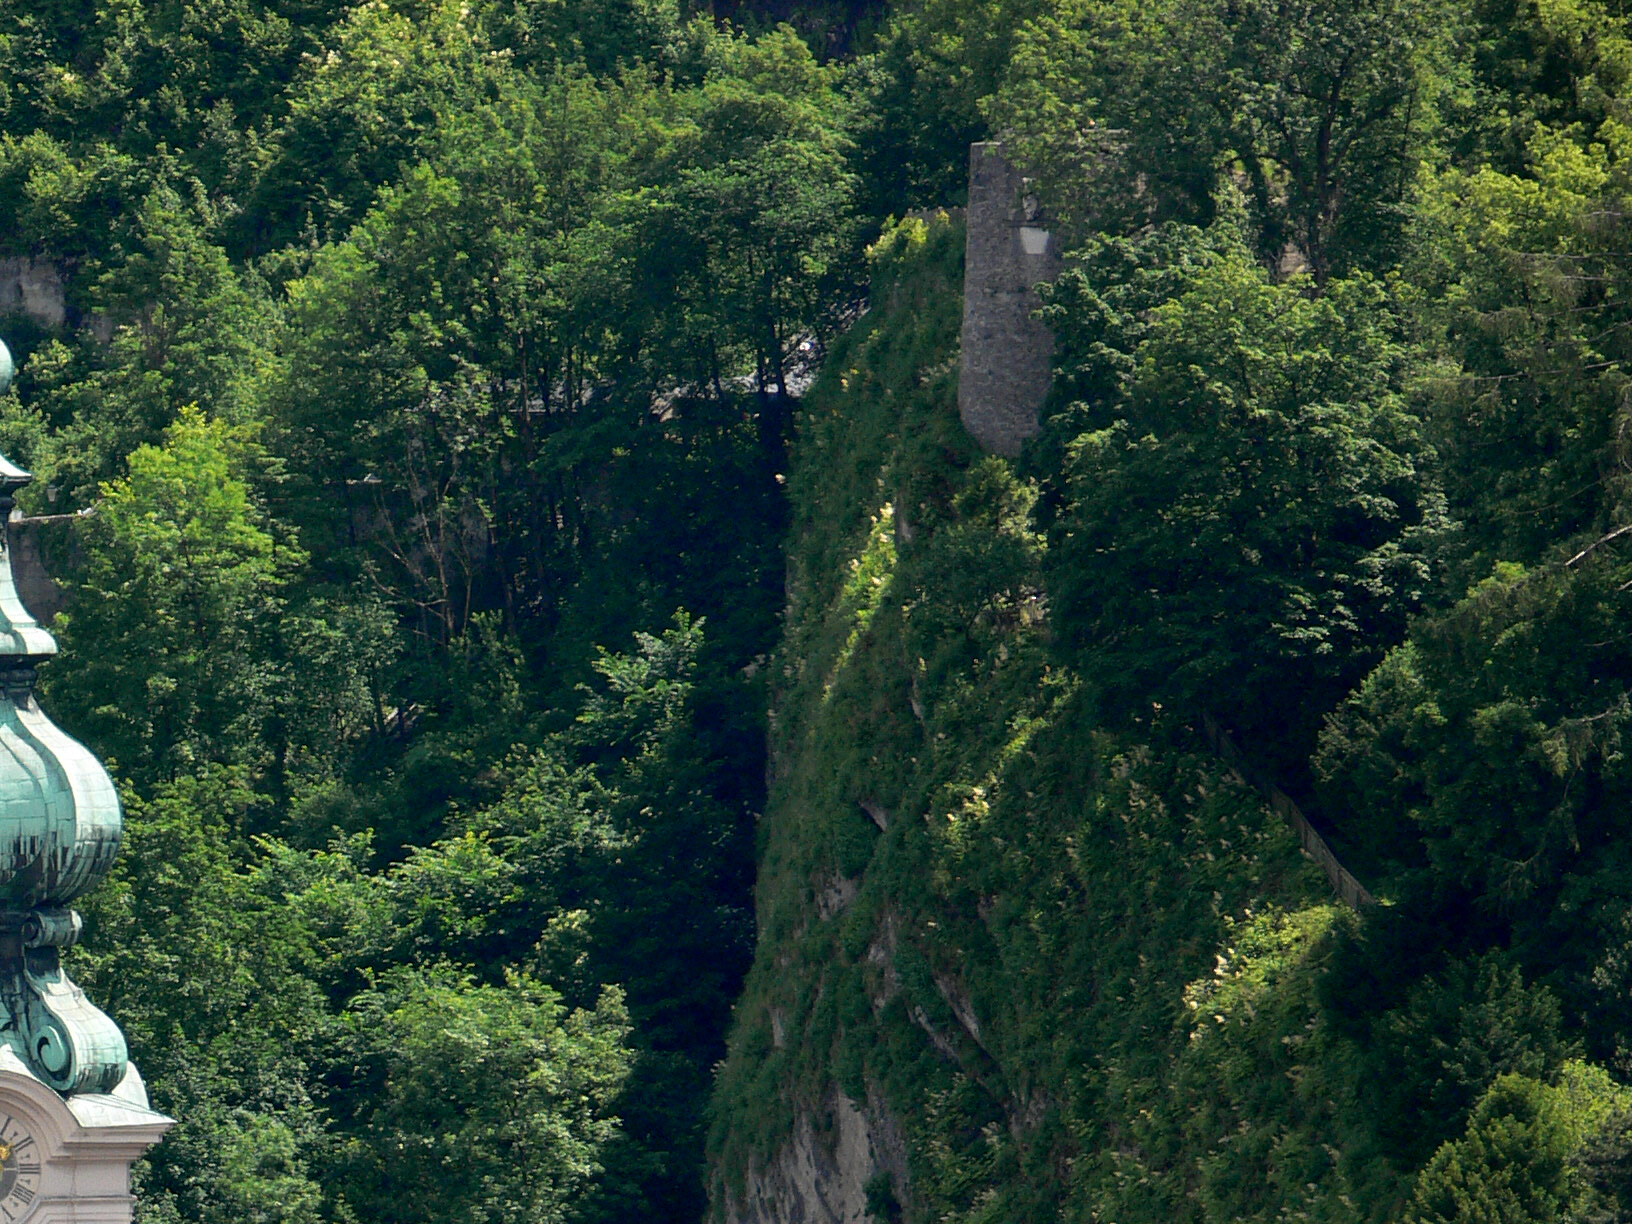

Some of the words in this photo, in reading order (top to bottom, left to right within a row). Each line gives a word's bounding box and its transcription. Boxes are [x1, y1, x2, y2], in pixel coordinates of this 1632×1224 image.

[0, 1116, 13, 1135] I
[13, 1134, 35, 1153] II
[19, 1163, 41, 1174] III
